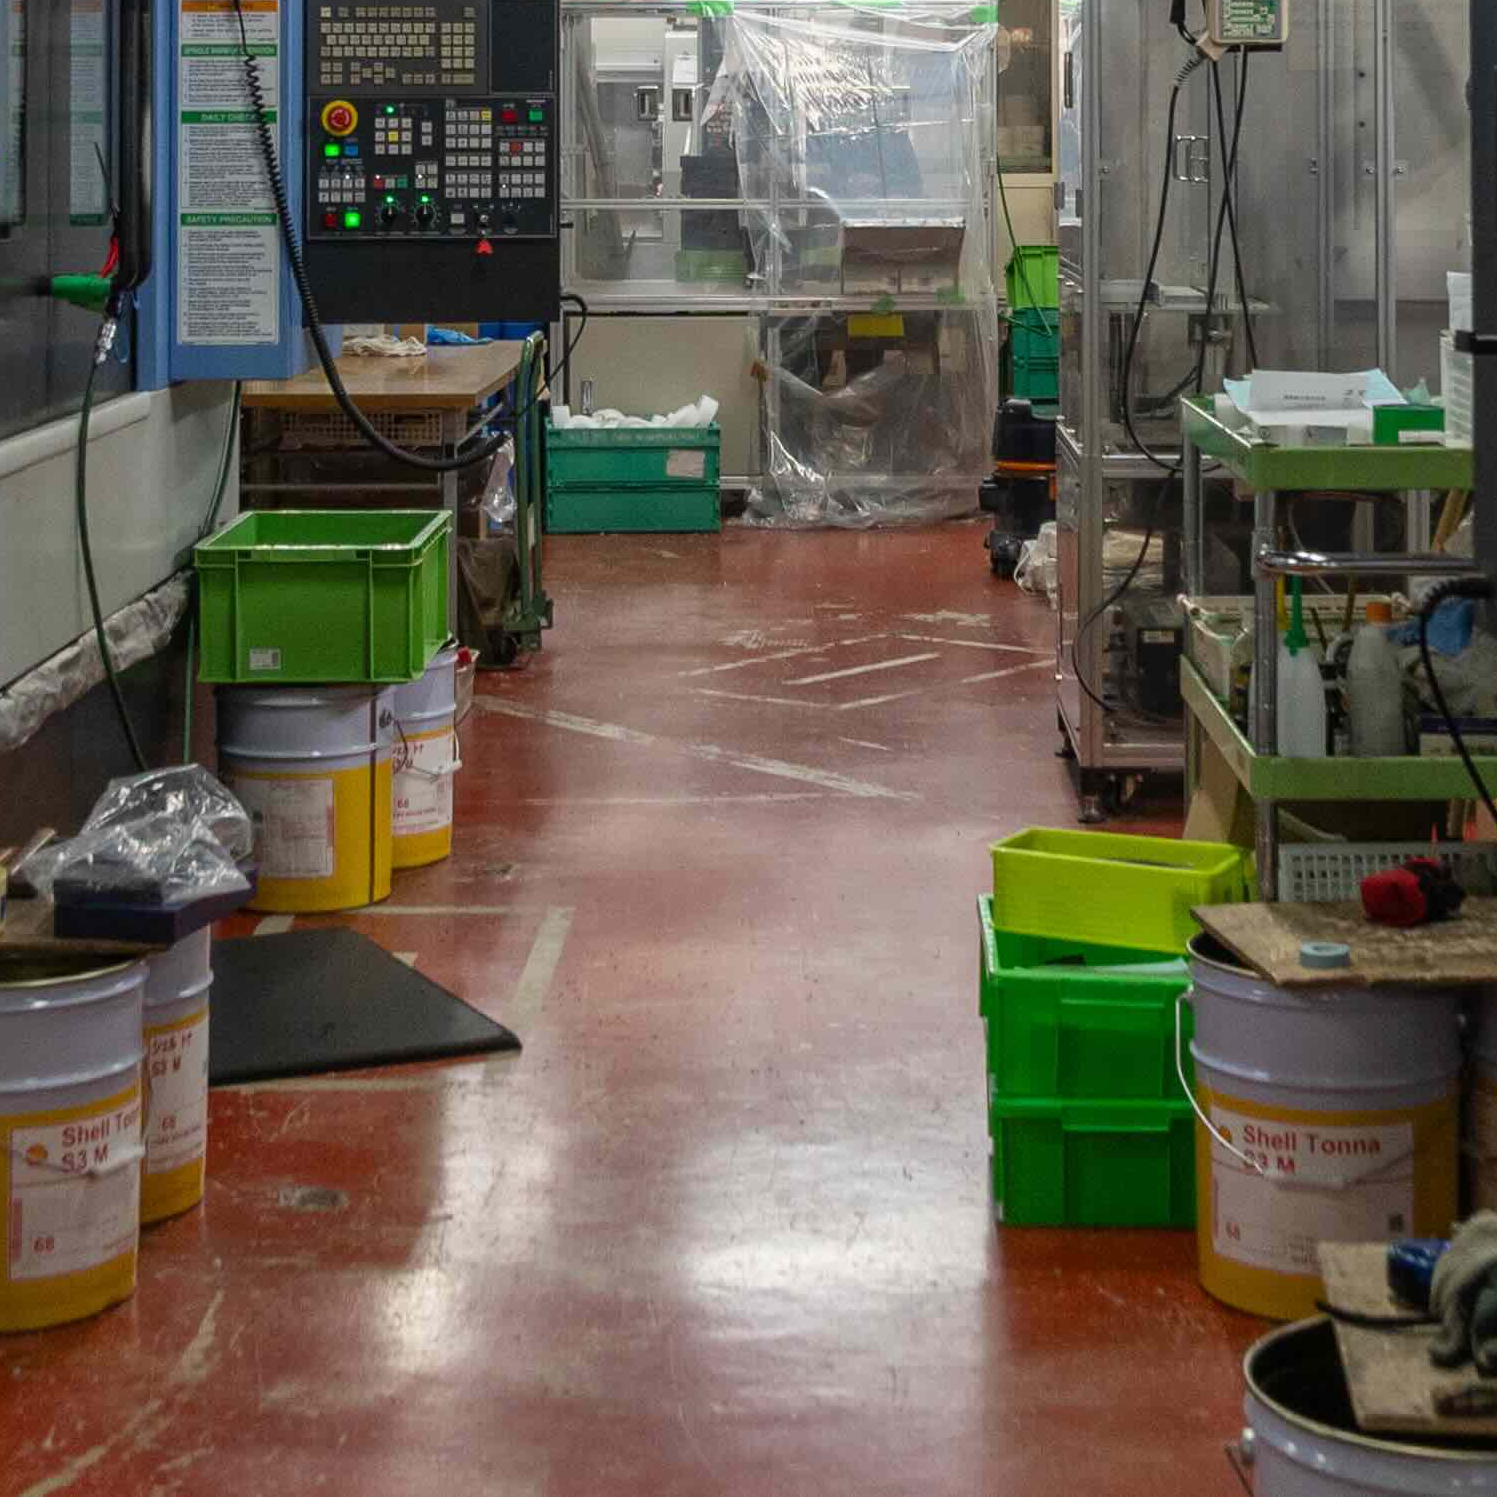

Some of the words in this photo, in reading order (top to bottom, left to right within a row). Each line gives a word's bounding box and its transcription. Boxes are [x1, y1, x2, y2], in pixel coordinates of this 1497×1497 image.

[62, 1117, 110, 1147] Shell
[1243, 1124, 1297, 1151] Shell
[1307, 1133, 1382, 1157] Tonna
[61, 1150, 87, 1174] S3
[93, 1143, 110, 1164] M
[1276, 1155, 1295, 1172] M
